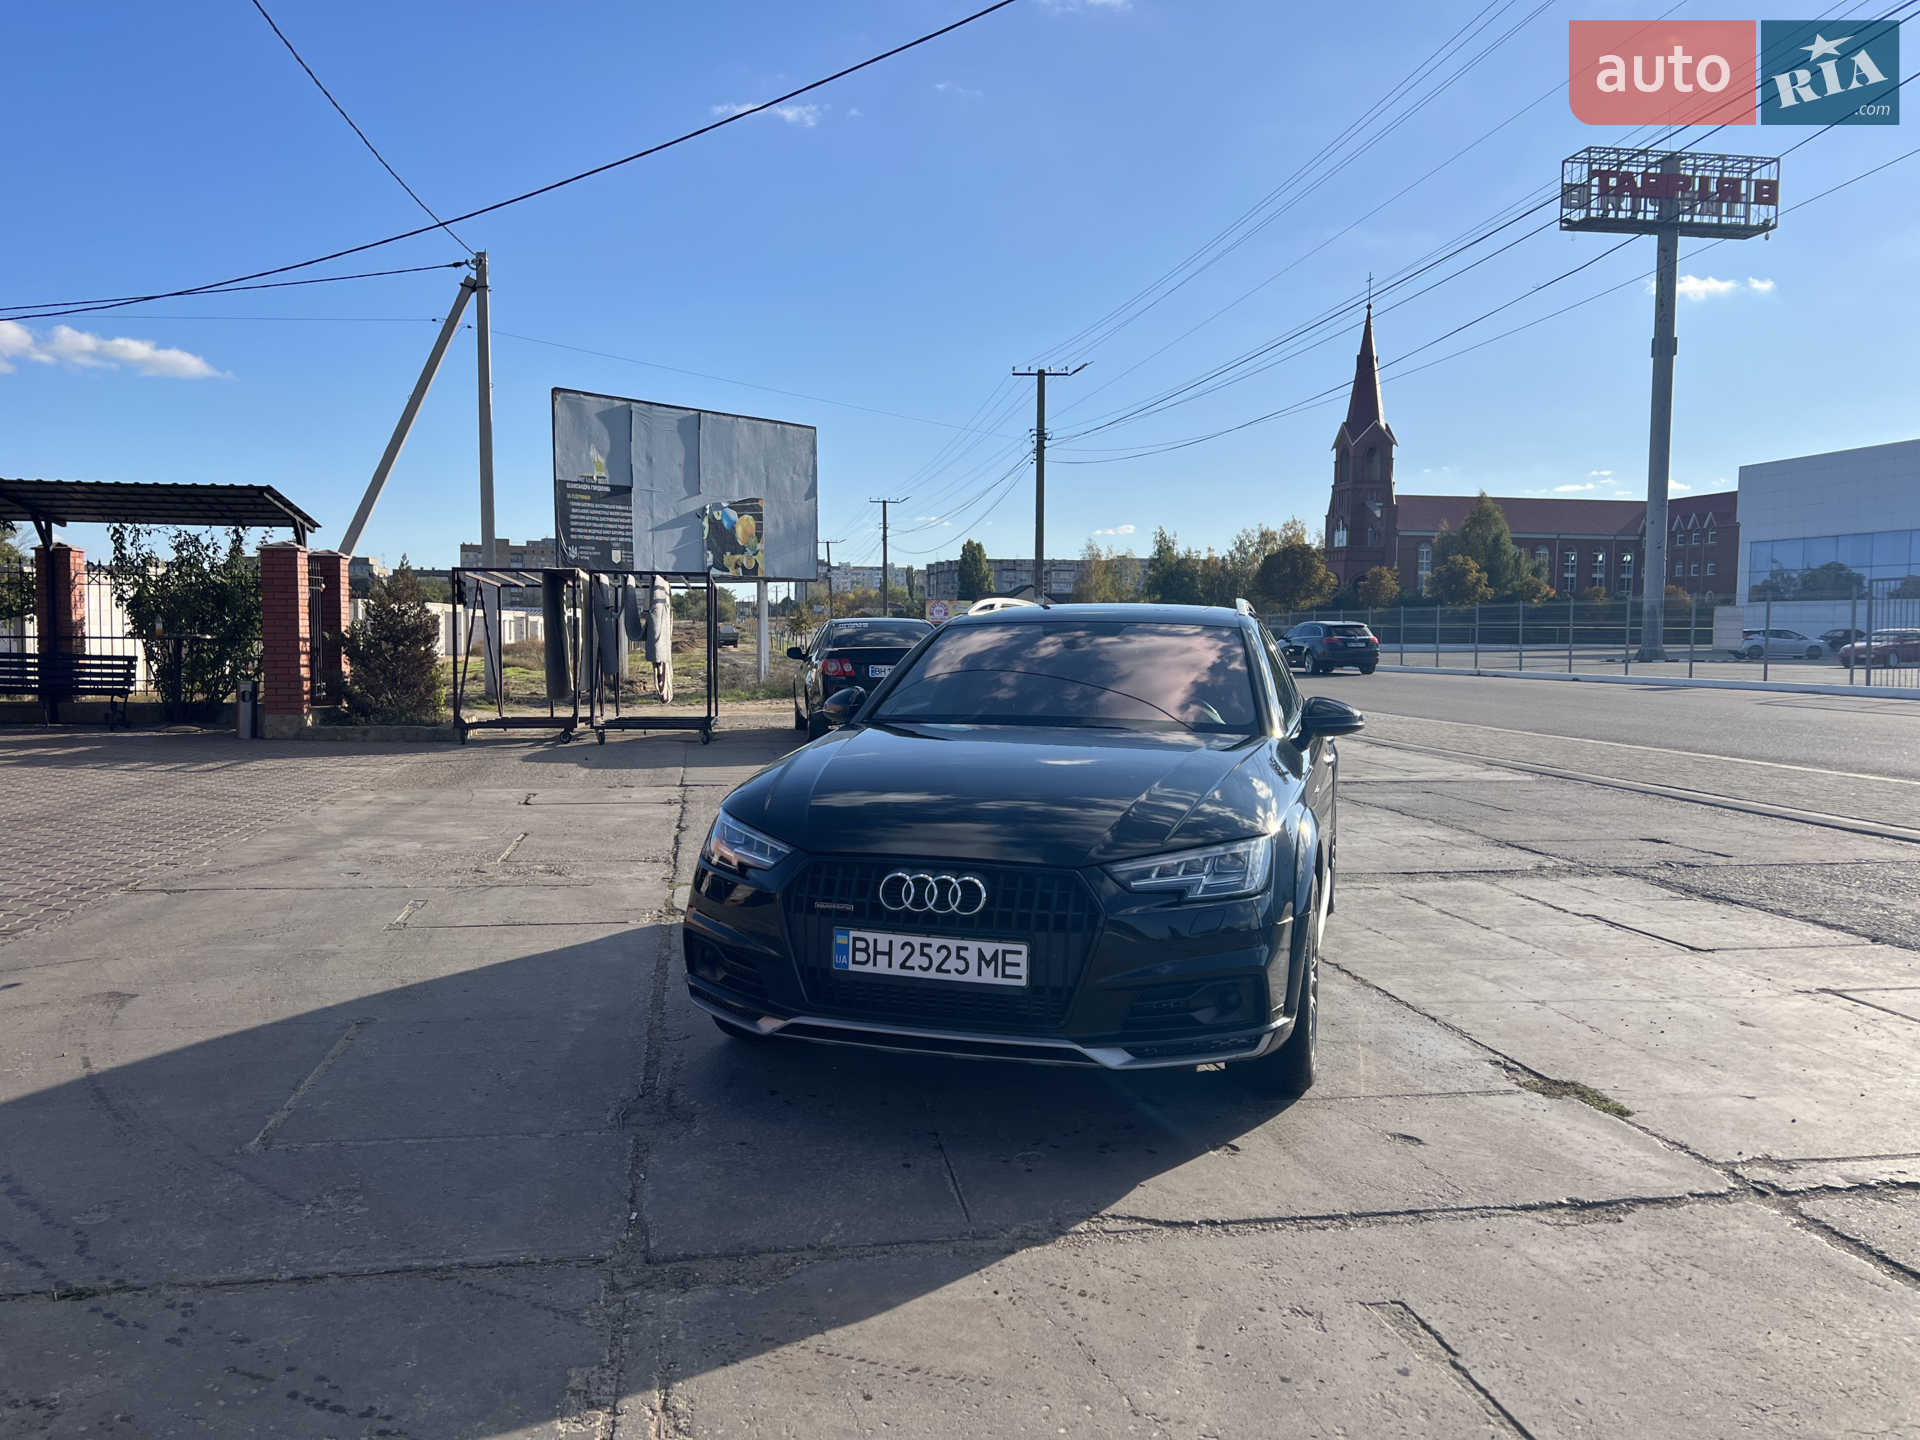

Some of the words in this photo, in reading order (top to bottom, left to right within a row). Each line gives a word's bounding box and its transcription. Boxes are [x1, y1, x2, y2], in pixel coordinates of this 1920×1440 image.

[1592, 169, 1742, 203] ТАВРІЯ
[816, 902, 852, 910] quattro
[835, 953, 848, 965] UA
[851, 936, 893, 968] BH
[899, 940, 970, 975] 2525
[977, 947, 1023, 980] ME
